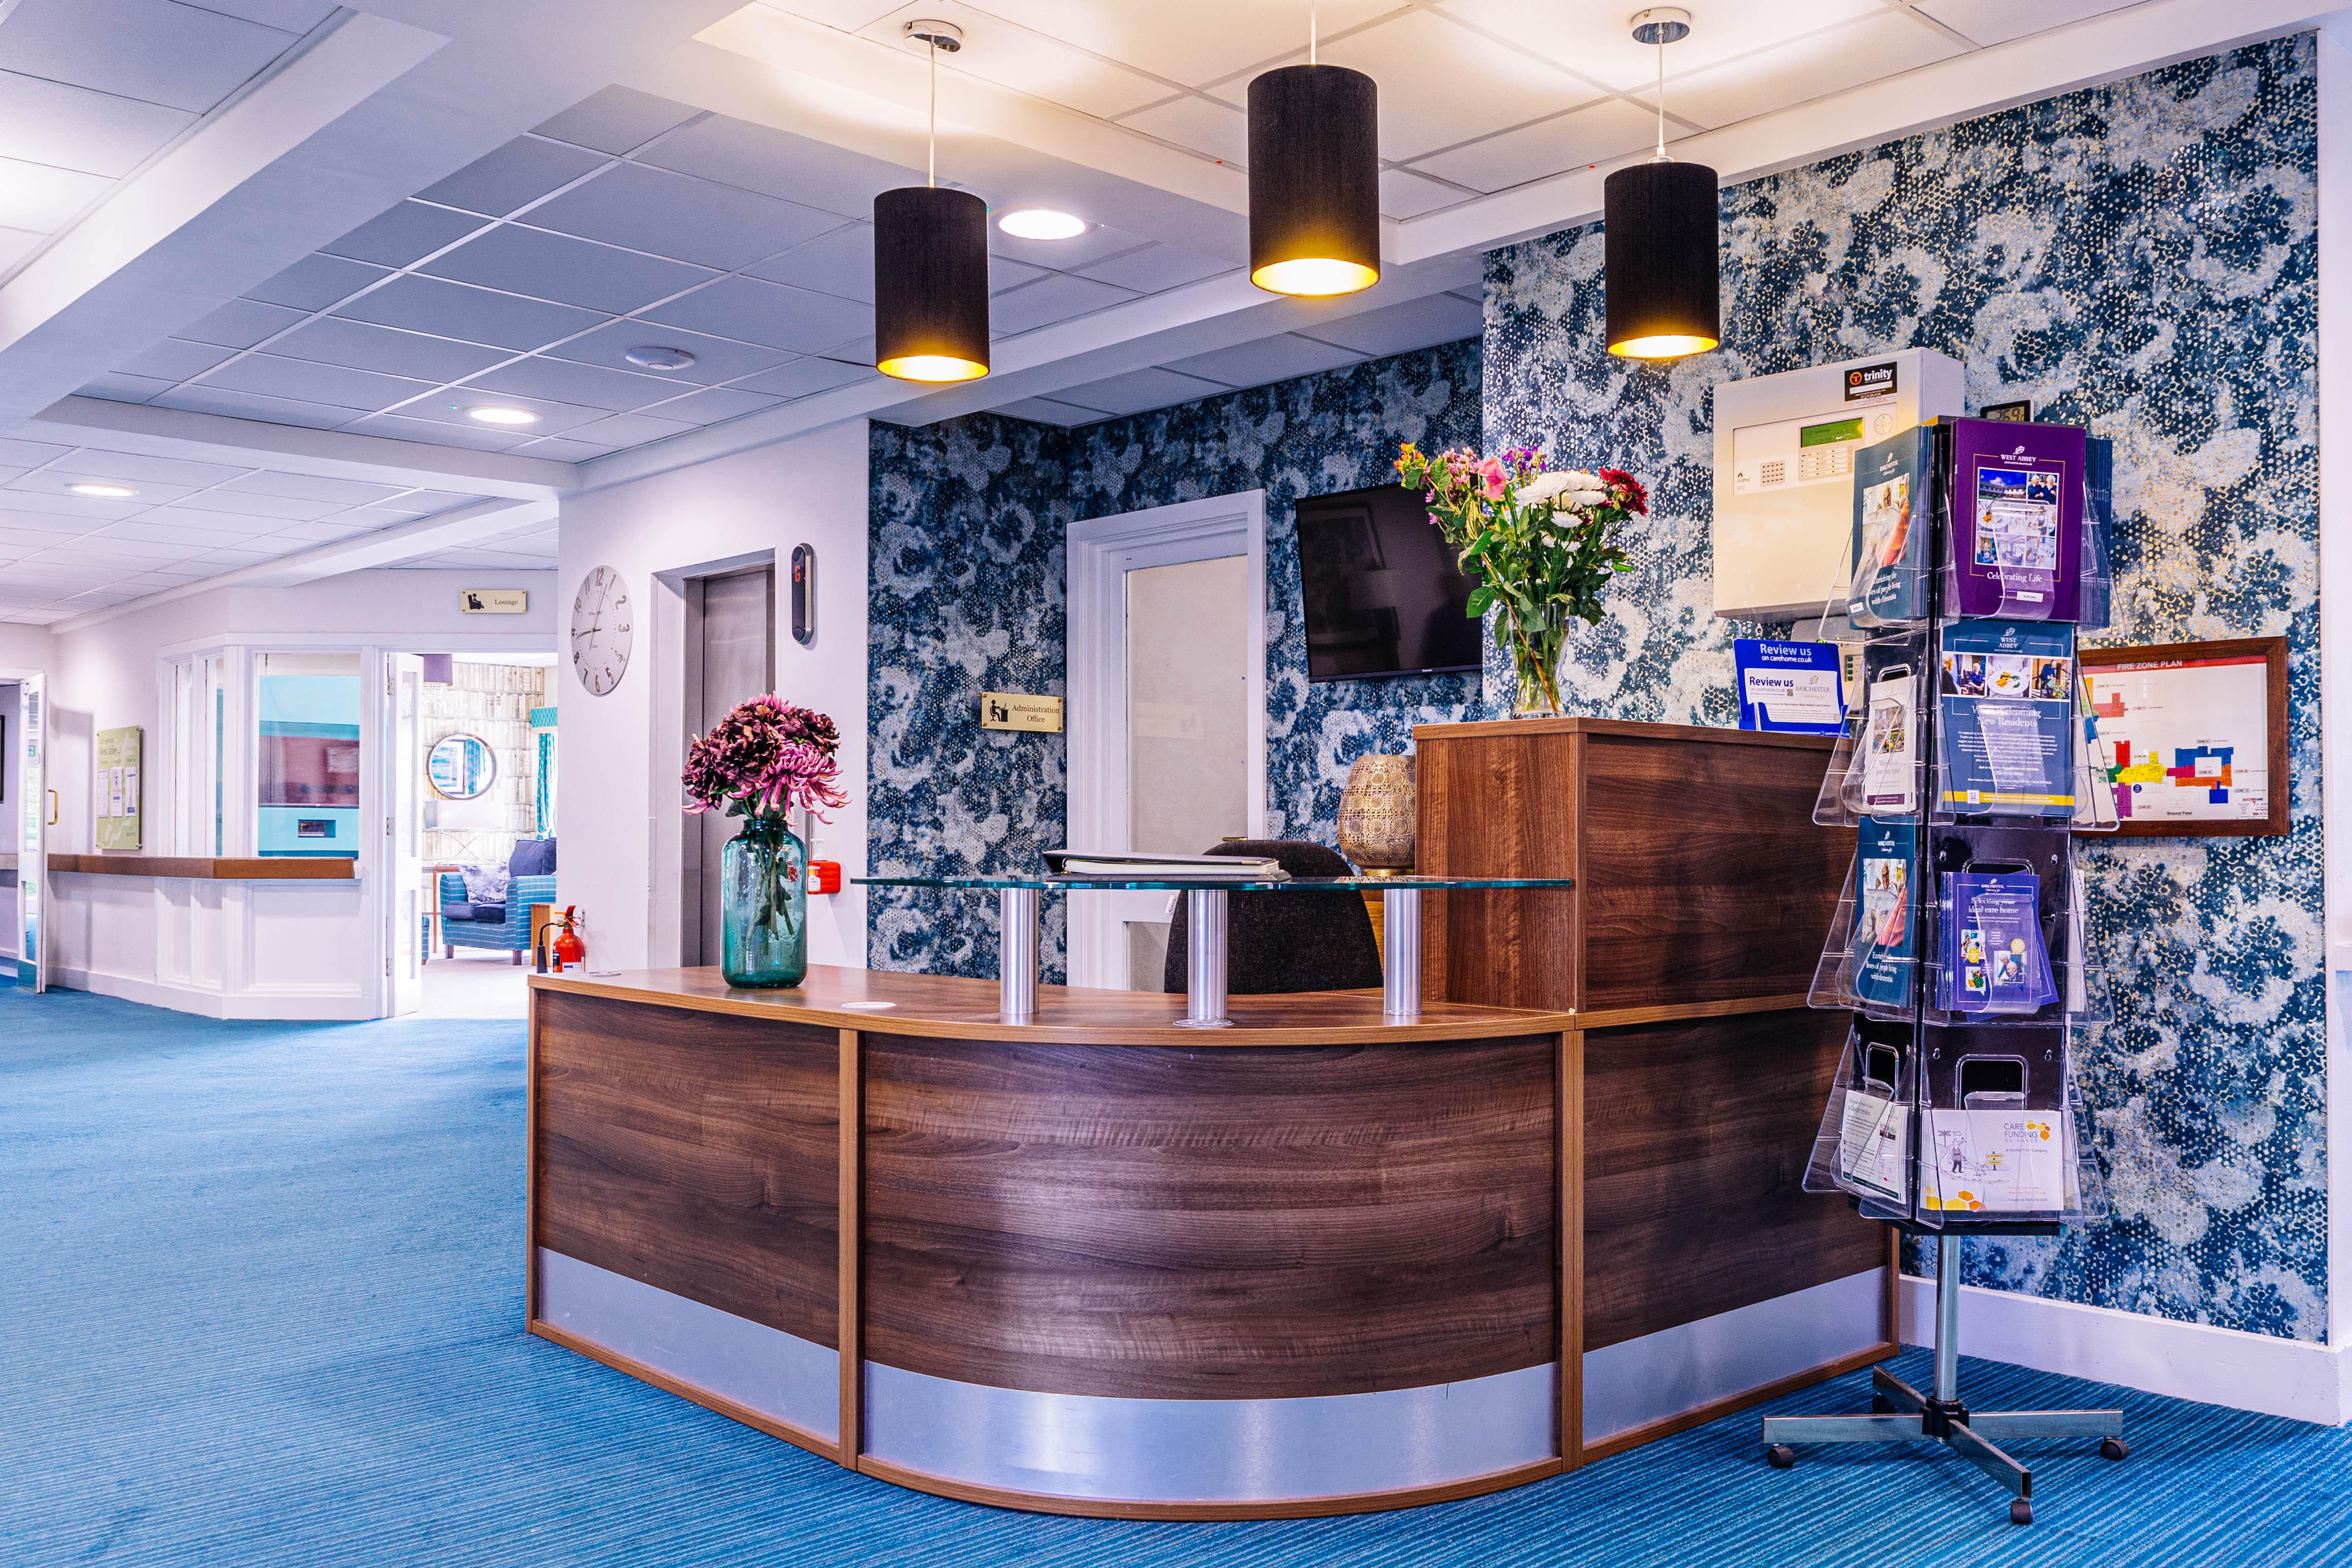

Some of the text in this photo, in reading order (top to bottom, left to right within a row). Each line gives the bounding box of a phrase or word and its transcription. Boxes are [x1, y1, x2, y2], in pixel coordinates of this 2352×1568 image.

[1863, 369, 1892, 381] trinity
[595, 568, 604, 586] 12
[609, 574, 616, 591] 1
[1987, 572, 2043, 583] Celebrating Life
[584, 575, 591, 595] 11
[574, 597, 581, 614] 10
[615, 595, 627, 610] 2
[618, 623, 630, 633] 3
[615, 650, 626, 664] 4
[1760, 644, 1812, 656] Review us
[574, 651, 580, 665] 8
[583, 668, 588, 685] 7
[606, 666, 614, 685] 5
[1749, 676, 1781, 687] Review
[595, 674, 600, 693] 6
[1012, 704, 1059, 714] Administration
[1026, 715, 1045, 723] Office
[1977, 717, 2037, 727] New Residents
[1971, 897, 1999, 906] Selecting
